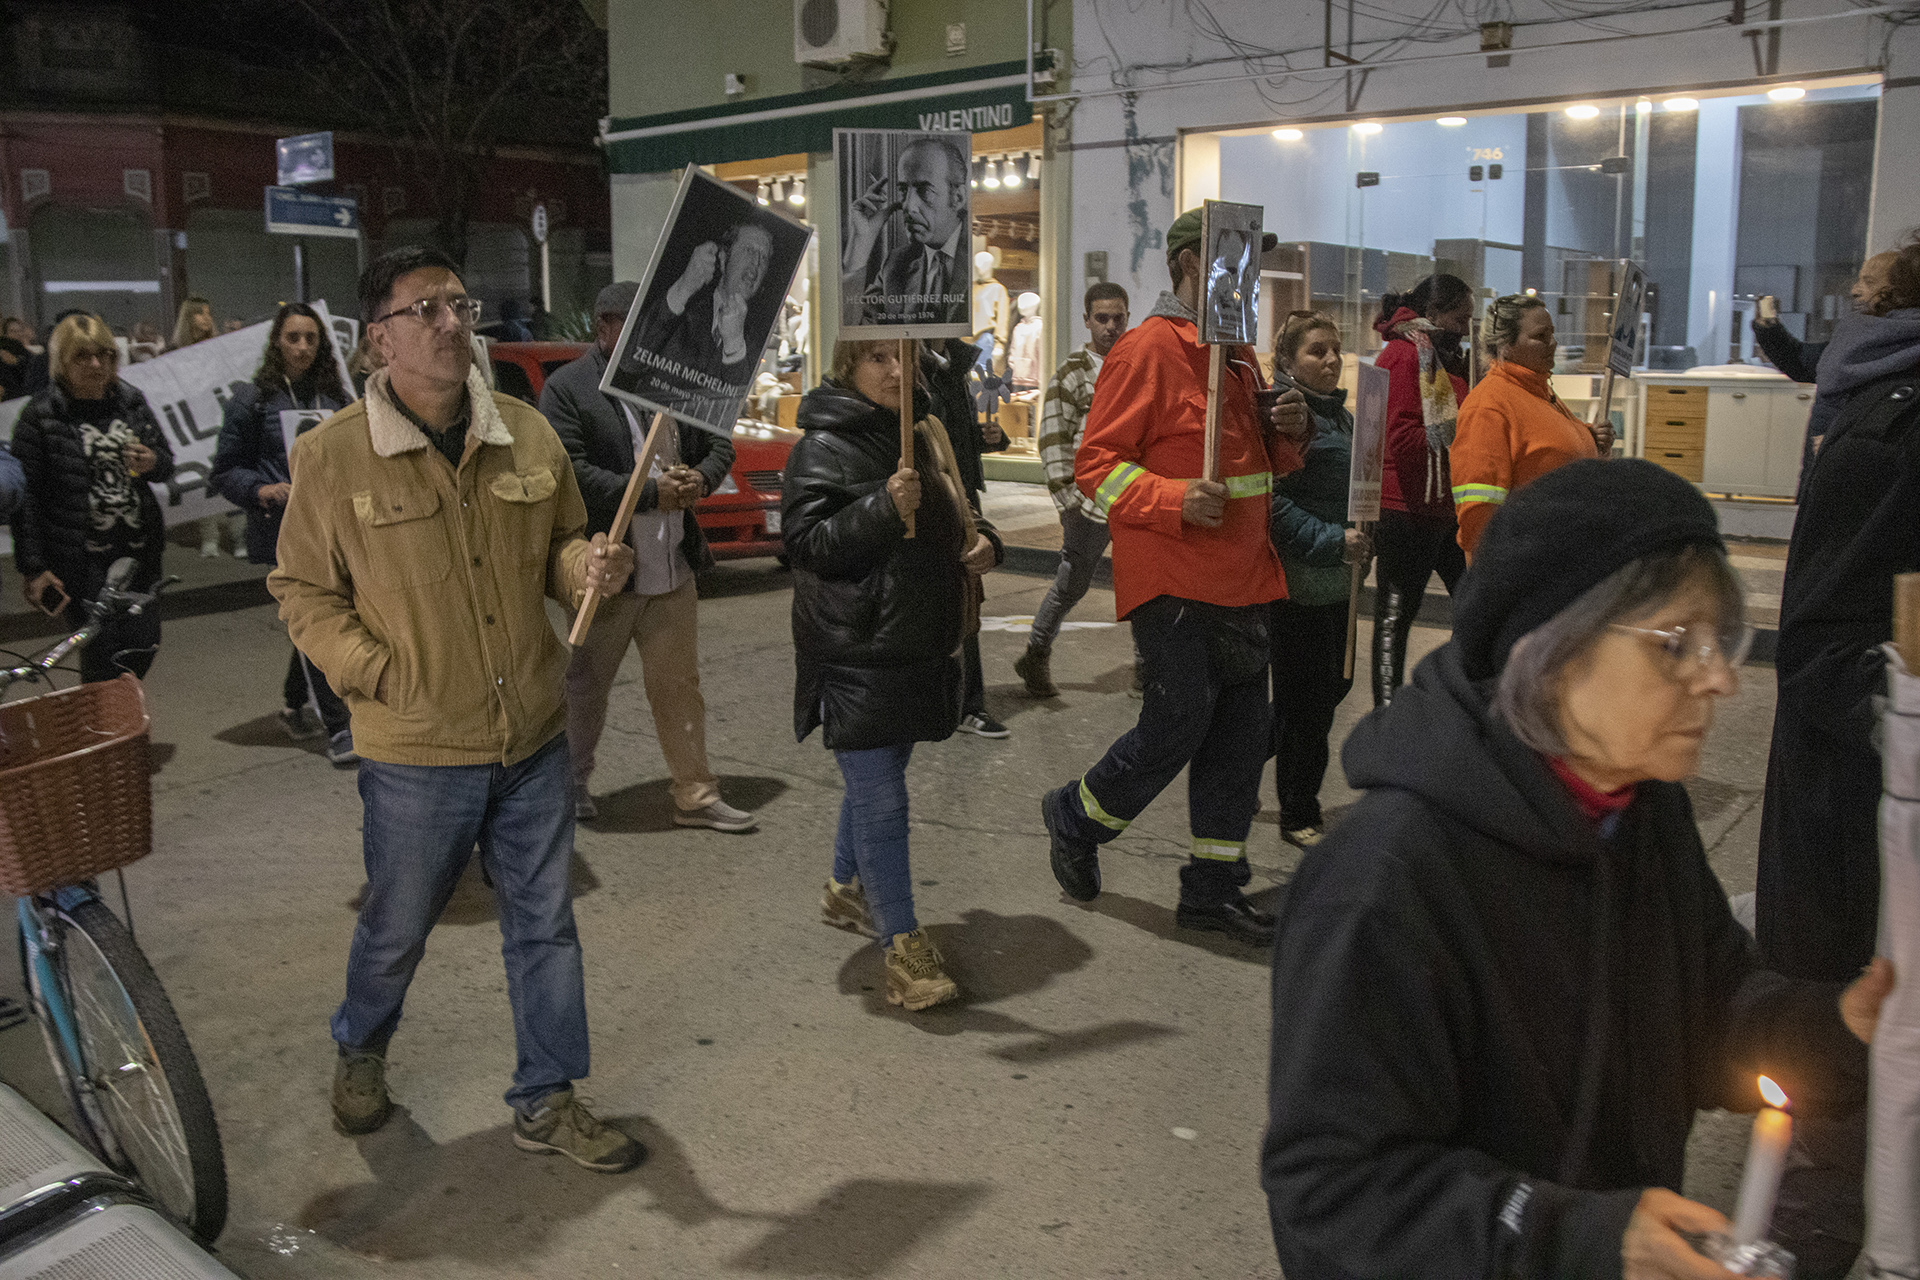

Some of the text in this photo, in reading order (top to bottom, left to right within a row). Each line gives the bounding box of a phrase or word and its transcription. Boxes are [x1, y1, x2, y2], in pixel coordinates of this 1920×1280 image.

[919, 103, 1012, 131] VALENTINO
[1472, 147, 1503, 161] 746
[887, 291, 940, 304] GUTIÉRREZ
[943, 293, 965, 303] RUIZ
[898, 313, 917, 321] mayo
[918, 311, 935, 319] 1976
[632, 346, 739, 398] ZELMAR MICHELINI
[650, 376, 661, 388] 20
[661, 380, 671, 391] de
[671, 386, 691, 400] mayo
